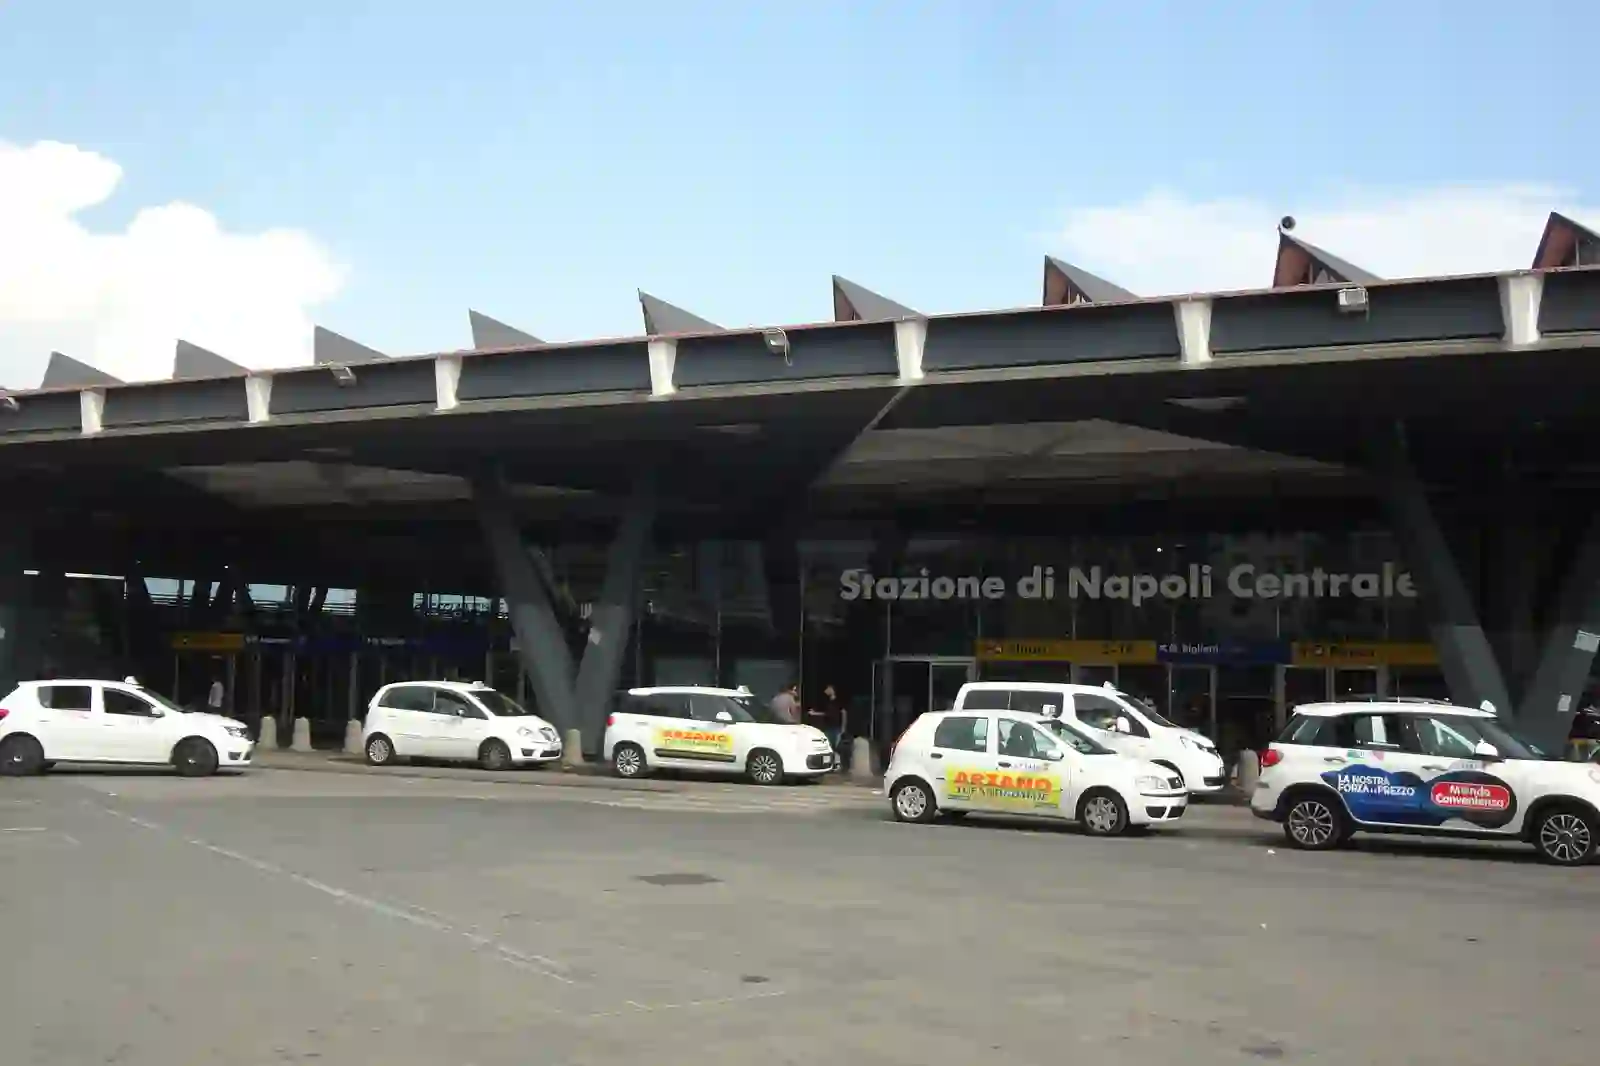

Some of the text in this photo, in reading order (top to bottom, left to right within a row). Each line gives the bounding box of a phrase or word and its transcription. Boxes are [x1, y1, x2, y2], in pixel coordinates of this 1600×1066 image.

[839, 561, 1418, 607] Stazione di Napoli Centrale
[1338, 774, 1390, 786] LA NOSTRA
[1338, 783, 1369, 793] FORZA
[1377, 785, 1415, 796] PREZZO
[1449, 784, 1491, 797] Mondo
